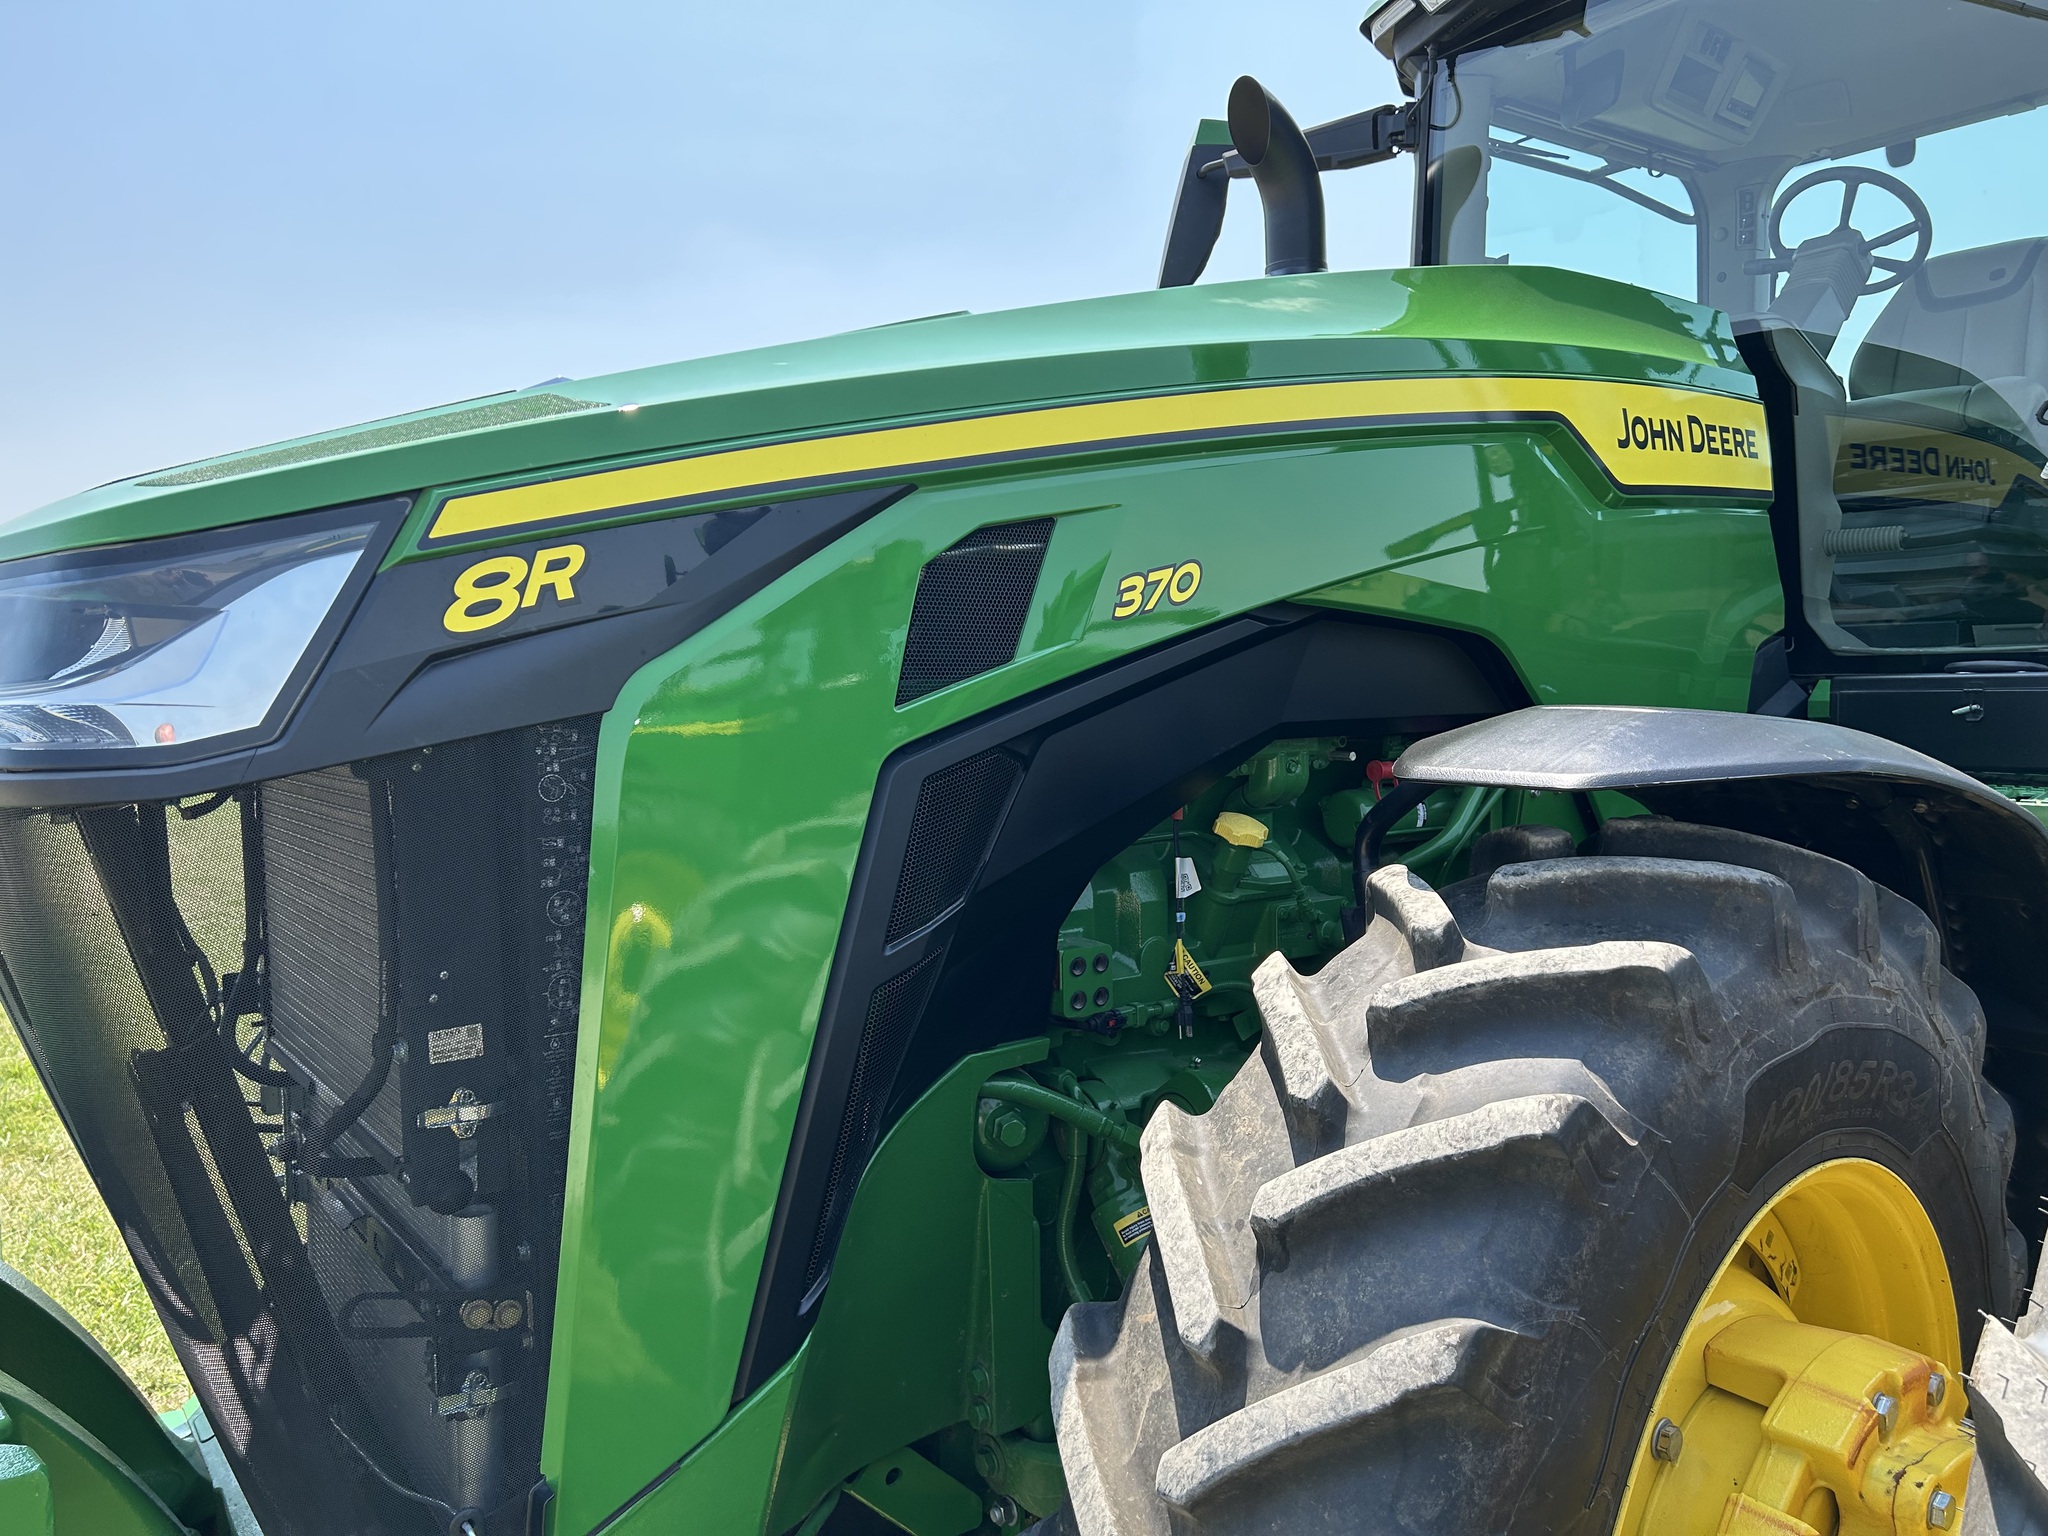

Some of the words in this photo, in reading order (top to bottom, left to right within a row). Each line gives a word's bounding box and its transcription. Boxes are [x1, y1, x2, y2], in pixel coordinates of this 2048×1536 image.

[1617, 408, 1684, 452] JOHN
[1687, 414, 1759, 459] DEERE
[443, 544, 586, 633] 8R
[1112, 560, 1202, 619] 370
[1182, 954, 1206, 985] CAUTION
